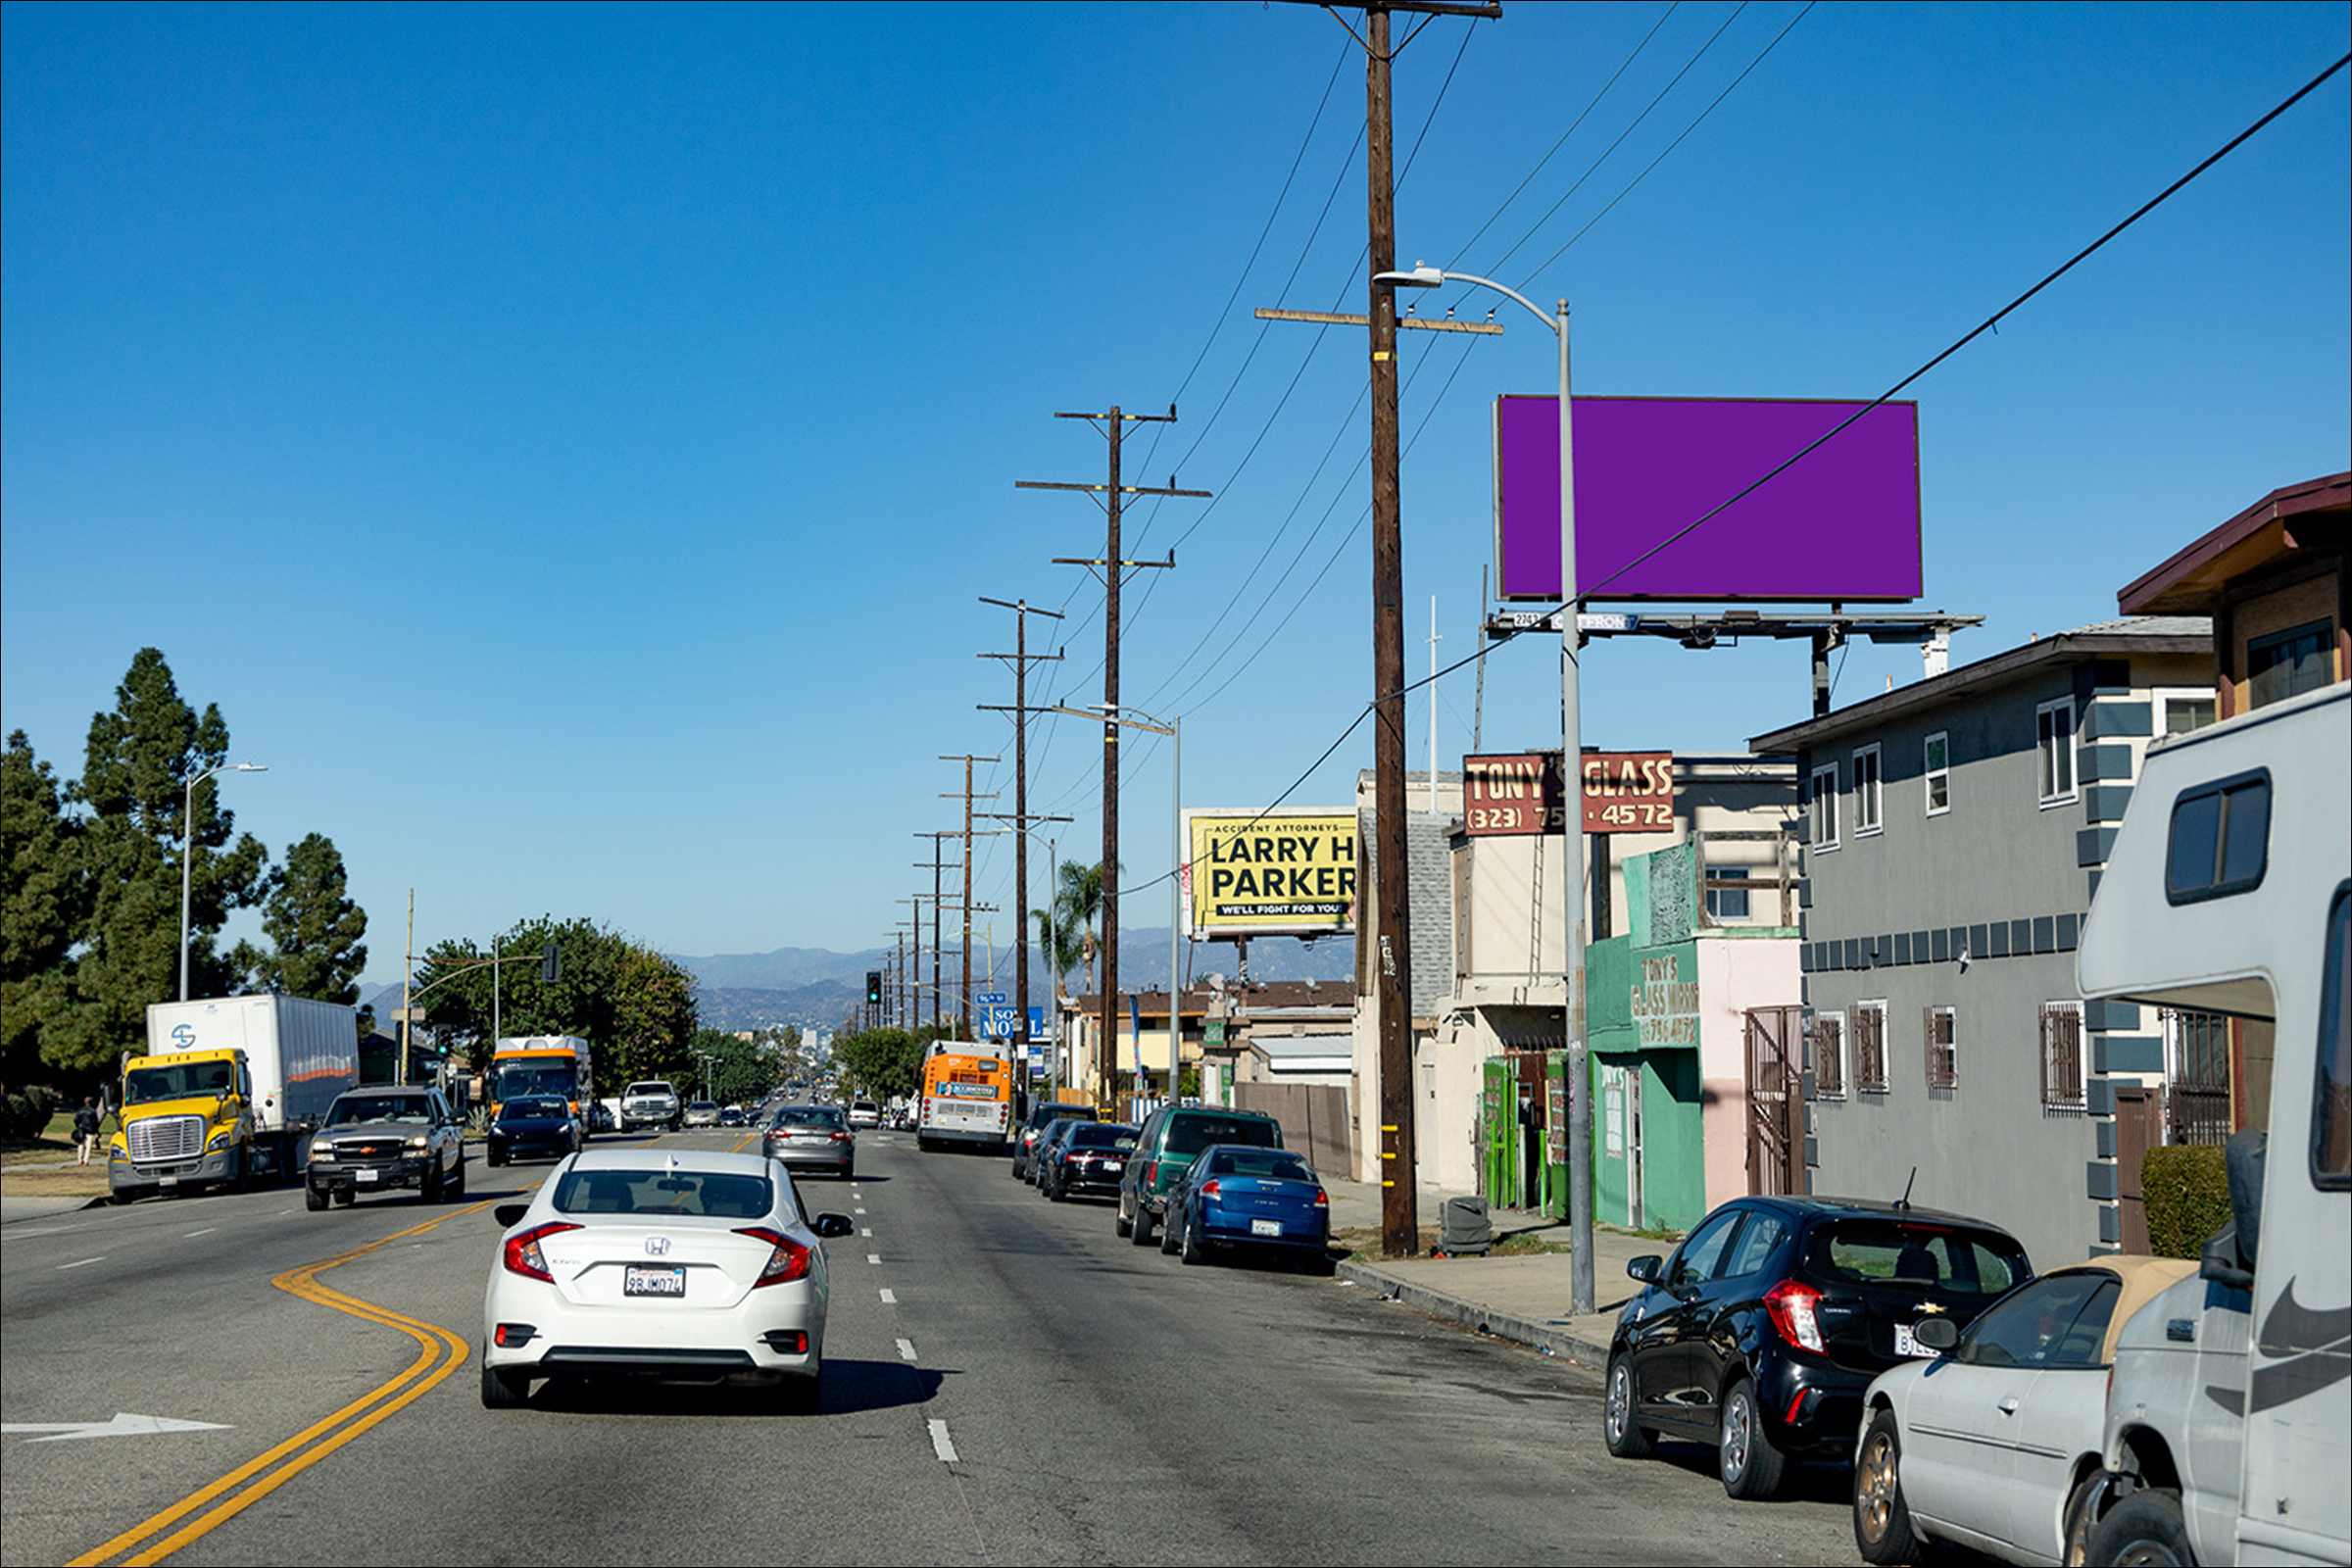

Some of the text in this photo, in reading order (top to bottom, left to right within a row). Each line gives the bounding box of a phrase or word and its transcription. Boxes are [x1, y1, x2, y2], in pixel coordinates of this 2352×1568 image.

[1584, 759, 1672, 797] GLASS
[1215, 823, 1339, 833] ACCIDENT ATTORNEYS
[1467, 804, 1673, 829] (323) 75 4572
[1211, 836, 1320, 863] LARRY
[1212, 867, 1356, 898] PARKER
[1221, 905, 1254, 914] WE'LL
[1257, 905, 1290, 913] FIGHT
[1293, 904, 1314, 913] FOR
[983, 1019, 1042, 1037] MOL
